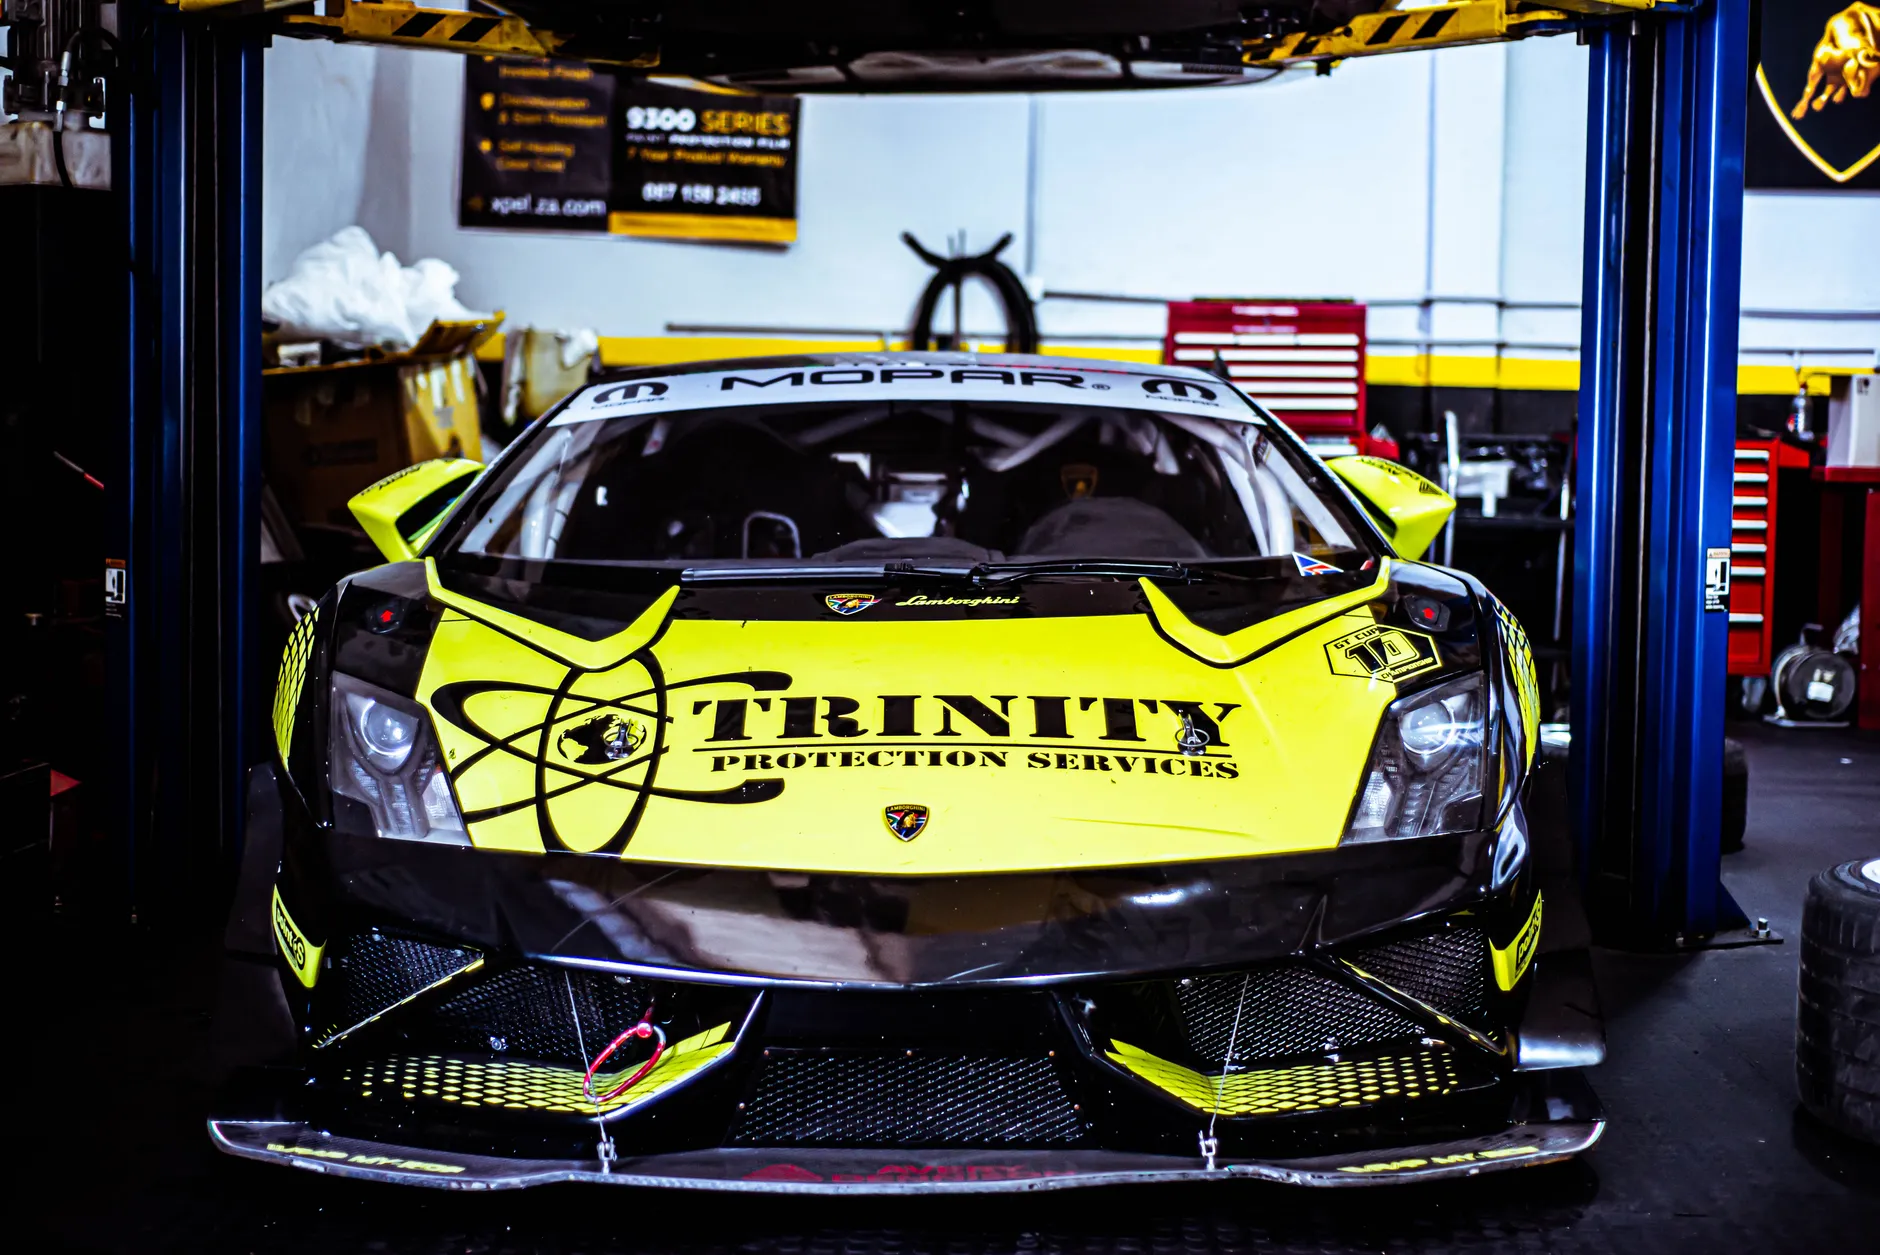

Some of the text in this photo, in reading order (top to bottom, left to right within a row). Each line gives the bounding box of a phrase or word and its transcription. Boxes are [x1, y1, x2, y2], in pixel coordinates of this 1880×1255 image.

[626, 106, 791, 136] 9300 SERIES
[895, 595, 1020, 607] Lamborghini
[1333, 627, 1379, 650] GT CUP
[693, 694, 1242, 748] TRINITY
[710, 750, 1240, 780] PROTECTION SERVICES
